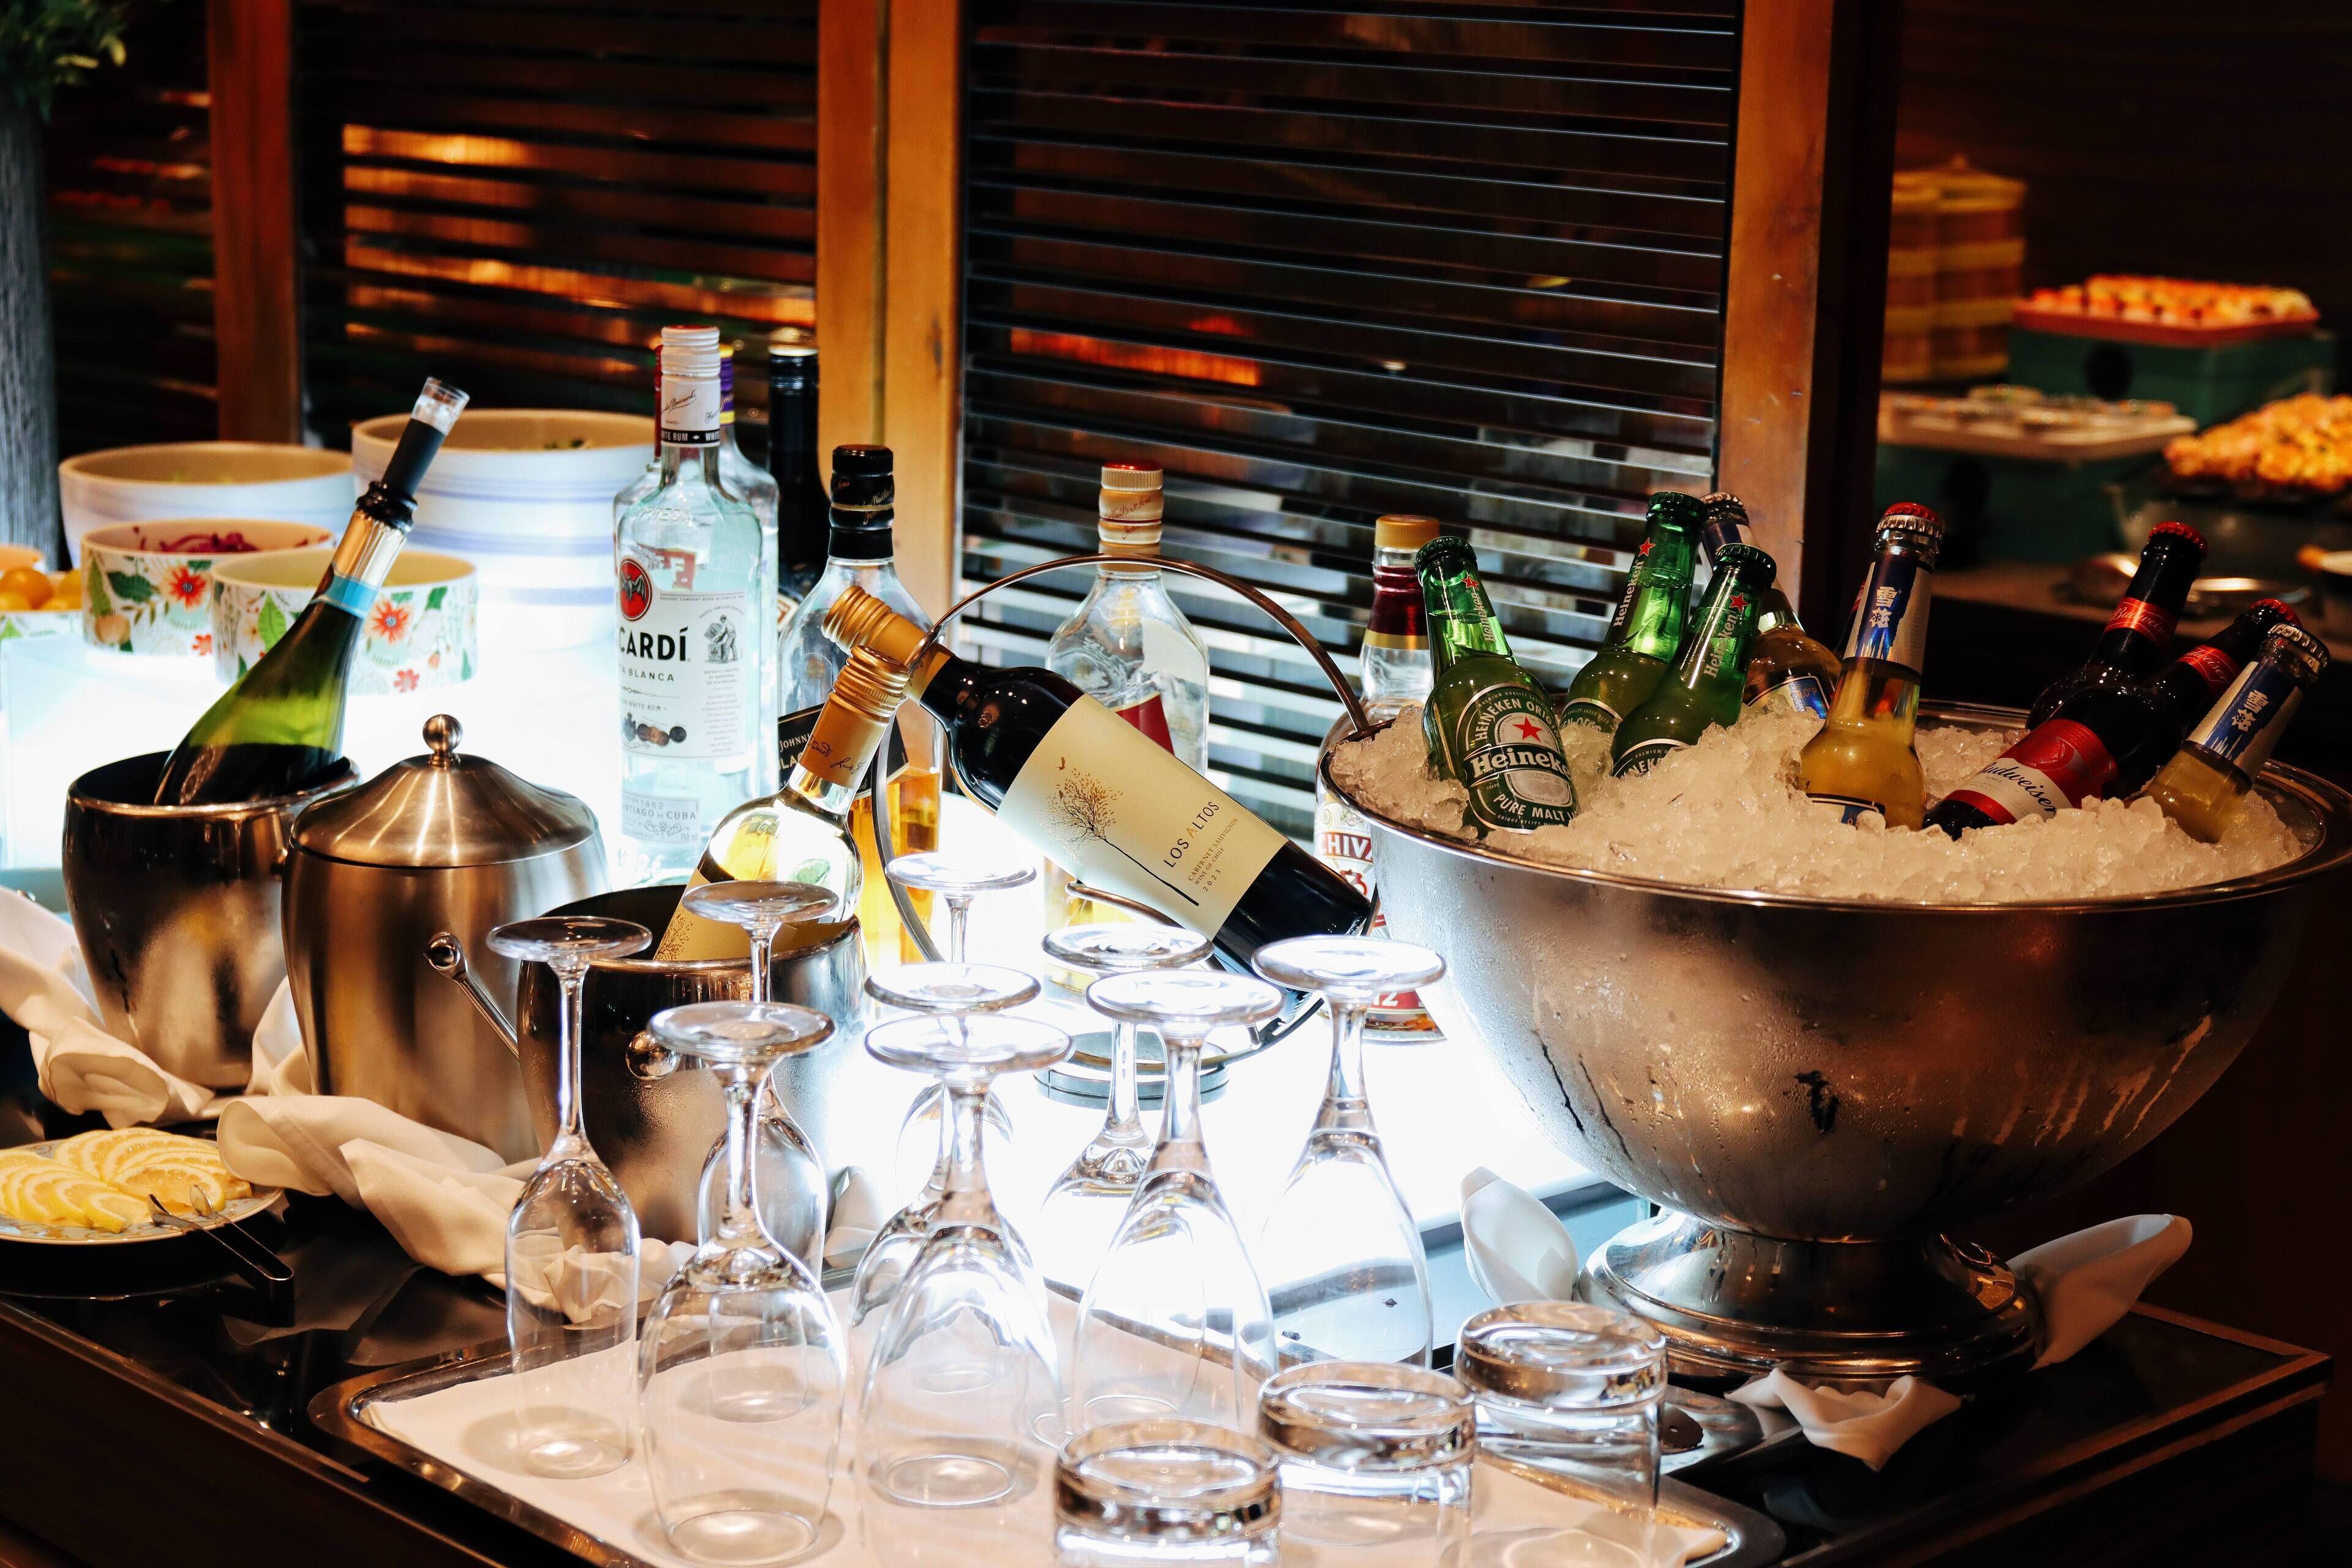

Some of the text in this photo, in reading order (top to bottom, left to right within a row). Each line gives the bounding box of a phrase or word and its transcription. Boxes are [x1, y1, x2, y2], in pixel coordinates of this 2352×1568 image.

[673, 432, 688, 442] RUM
[1613, 560, 1644, 627] Heineken
[1869, 586, 1898, 628] 雪花
[1471, 592, 1496, 643] Heineken
[2112, 605, 2165, 633] Budweis
[628, 668, 674, 682] BLANCA
[2183, 646, 2228, 682] dweiser
[628, 701, 645, 710] WHITE
[1478, 693, 1503, 707] PREMIUM
[2231, 689, 2269, 732] 雪花
[1475, 698, 1522, 741] HEINEKEN
[1635, 749, 1661, 759] PREMIUM
[640, 799, 663, 810] 1862
[666, 811, 696, 820] CUBA
[1493, 793, 1526, 816] PURE
[1531, 807, 1566, 822] MALT
[1497, 815, 1518, 823] UNIQUE
[680, 833, 690, 842] 750
[1163, 801, 1219, 868] LOS ALTOS
[1188, 818, 1239, 881] CABERNET SAUVIGNON
[1195, 846, 1225, 886] WINE OF CHILE
[1203, 869, 1221, 892] 2023
